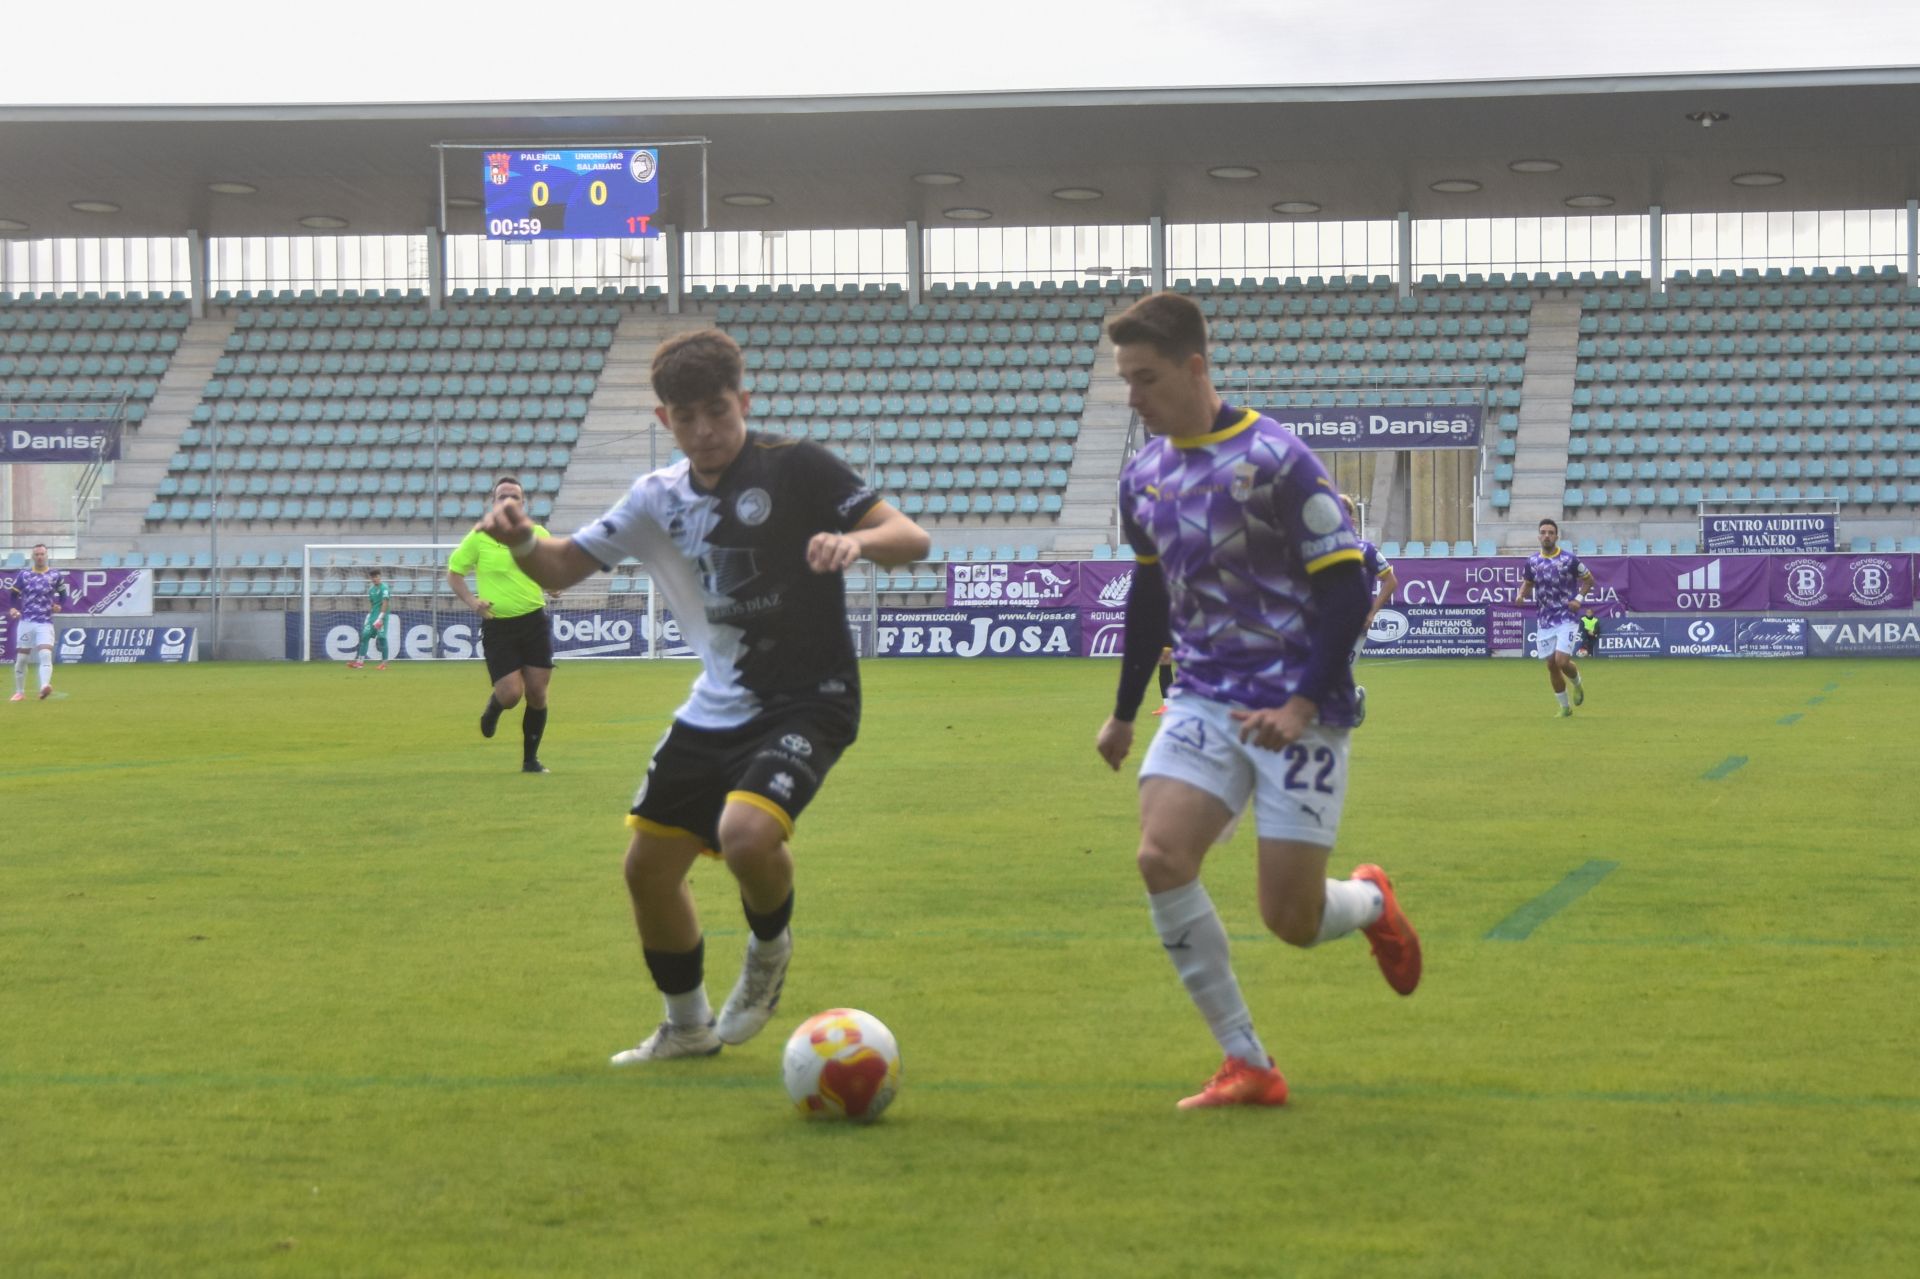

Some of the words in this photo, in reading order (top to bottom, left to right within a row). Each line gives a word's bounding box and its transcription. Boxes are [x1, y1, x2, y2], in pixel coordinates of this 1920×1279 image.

[520, 153, 561, 161] PALENCIA
[575, 152, 624, 160] UNIONISTAS
[576, 163, 622, 171] SALAMANC
[531, 181, 549, 206] 0
[589, 180, 608, 206] 0
[490, 218, 542, 235] 00:59
[626, 216, 651, 233] 1T
[1281, 414, 1357, 436] anisa
[1368, 413, 1467, 435] Danisa
[12, 428, 106, 450] Danisa
[1713, 519, 1763, 532] CENTRO
[1765, 518, 1825, 531] AUDITIVO
[1742, 532, 1796, 547] MAÑERO
[1465, 567, 1525, 583] HOTEL
[954, 582, 1003, 599] RIOS
[1466, 587, 1537, 603] CASTILL
[1677, 593, 1721, 609] OVB
[881, 614, 893, 622] DE
[895, 612, 968, 622] CONSTRUCCIÓN
[998, 611, 1077, 621] www.ferjosa.es
[1408, 608, 1437, 616] CECINAS
[1445, 608, 1486, 616] EMBUTIDOS
[553, 614, 633, 642] beko
[641, 614, 681, 642] be
[1422, 619, 1472, 627] HERMANOS
[325, 612, 486, 660] edes
[1409, 627, 1460, 635] CABALLERO
[1462, 627, 1486, 635] ROJO
[1361, 645, 1487, 657] www.cecinascaballerorojo.es
[1598, 637, 1661, 650] LEBANZA
[101, 648, 146, 659] PROTECCIÓN
[1284, 743, 1334, 794] 22
